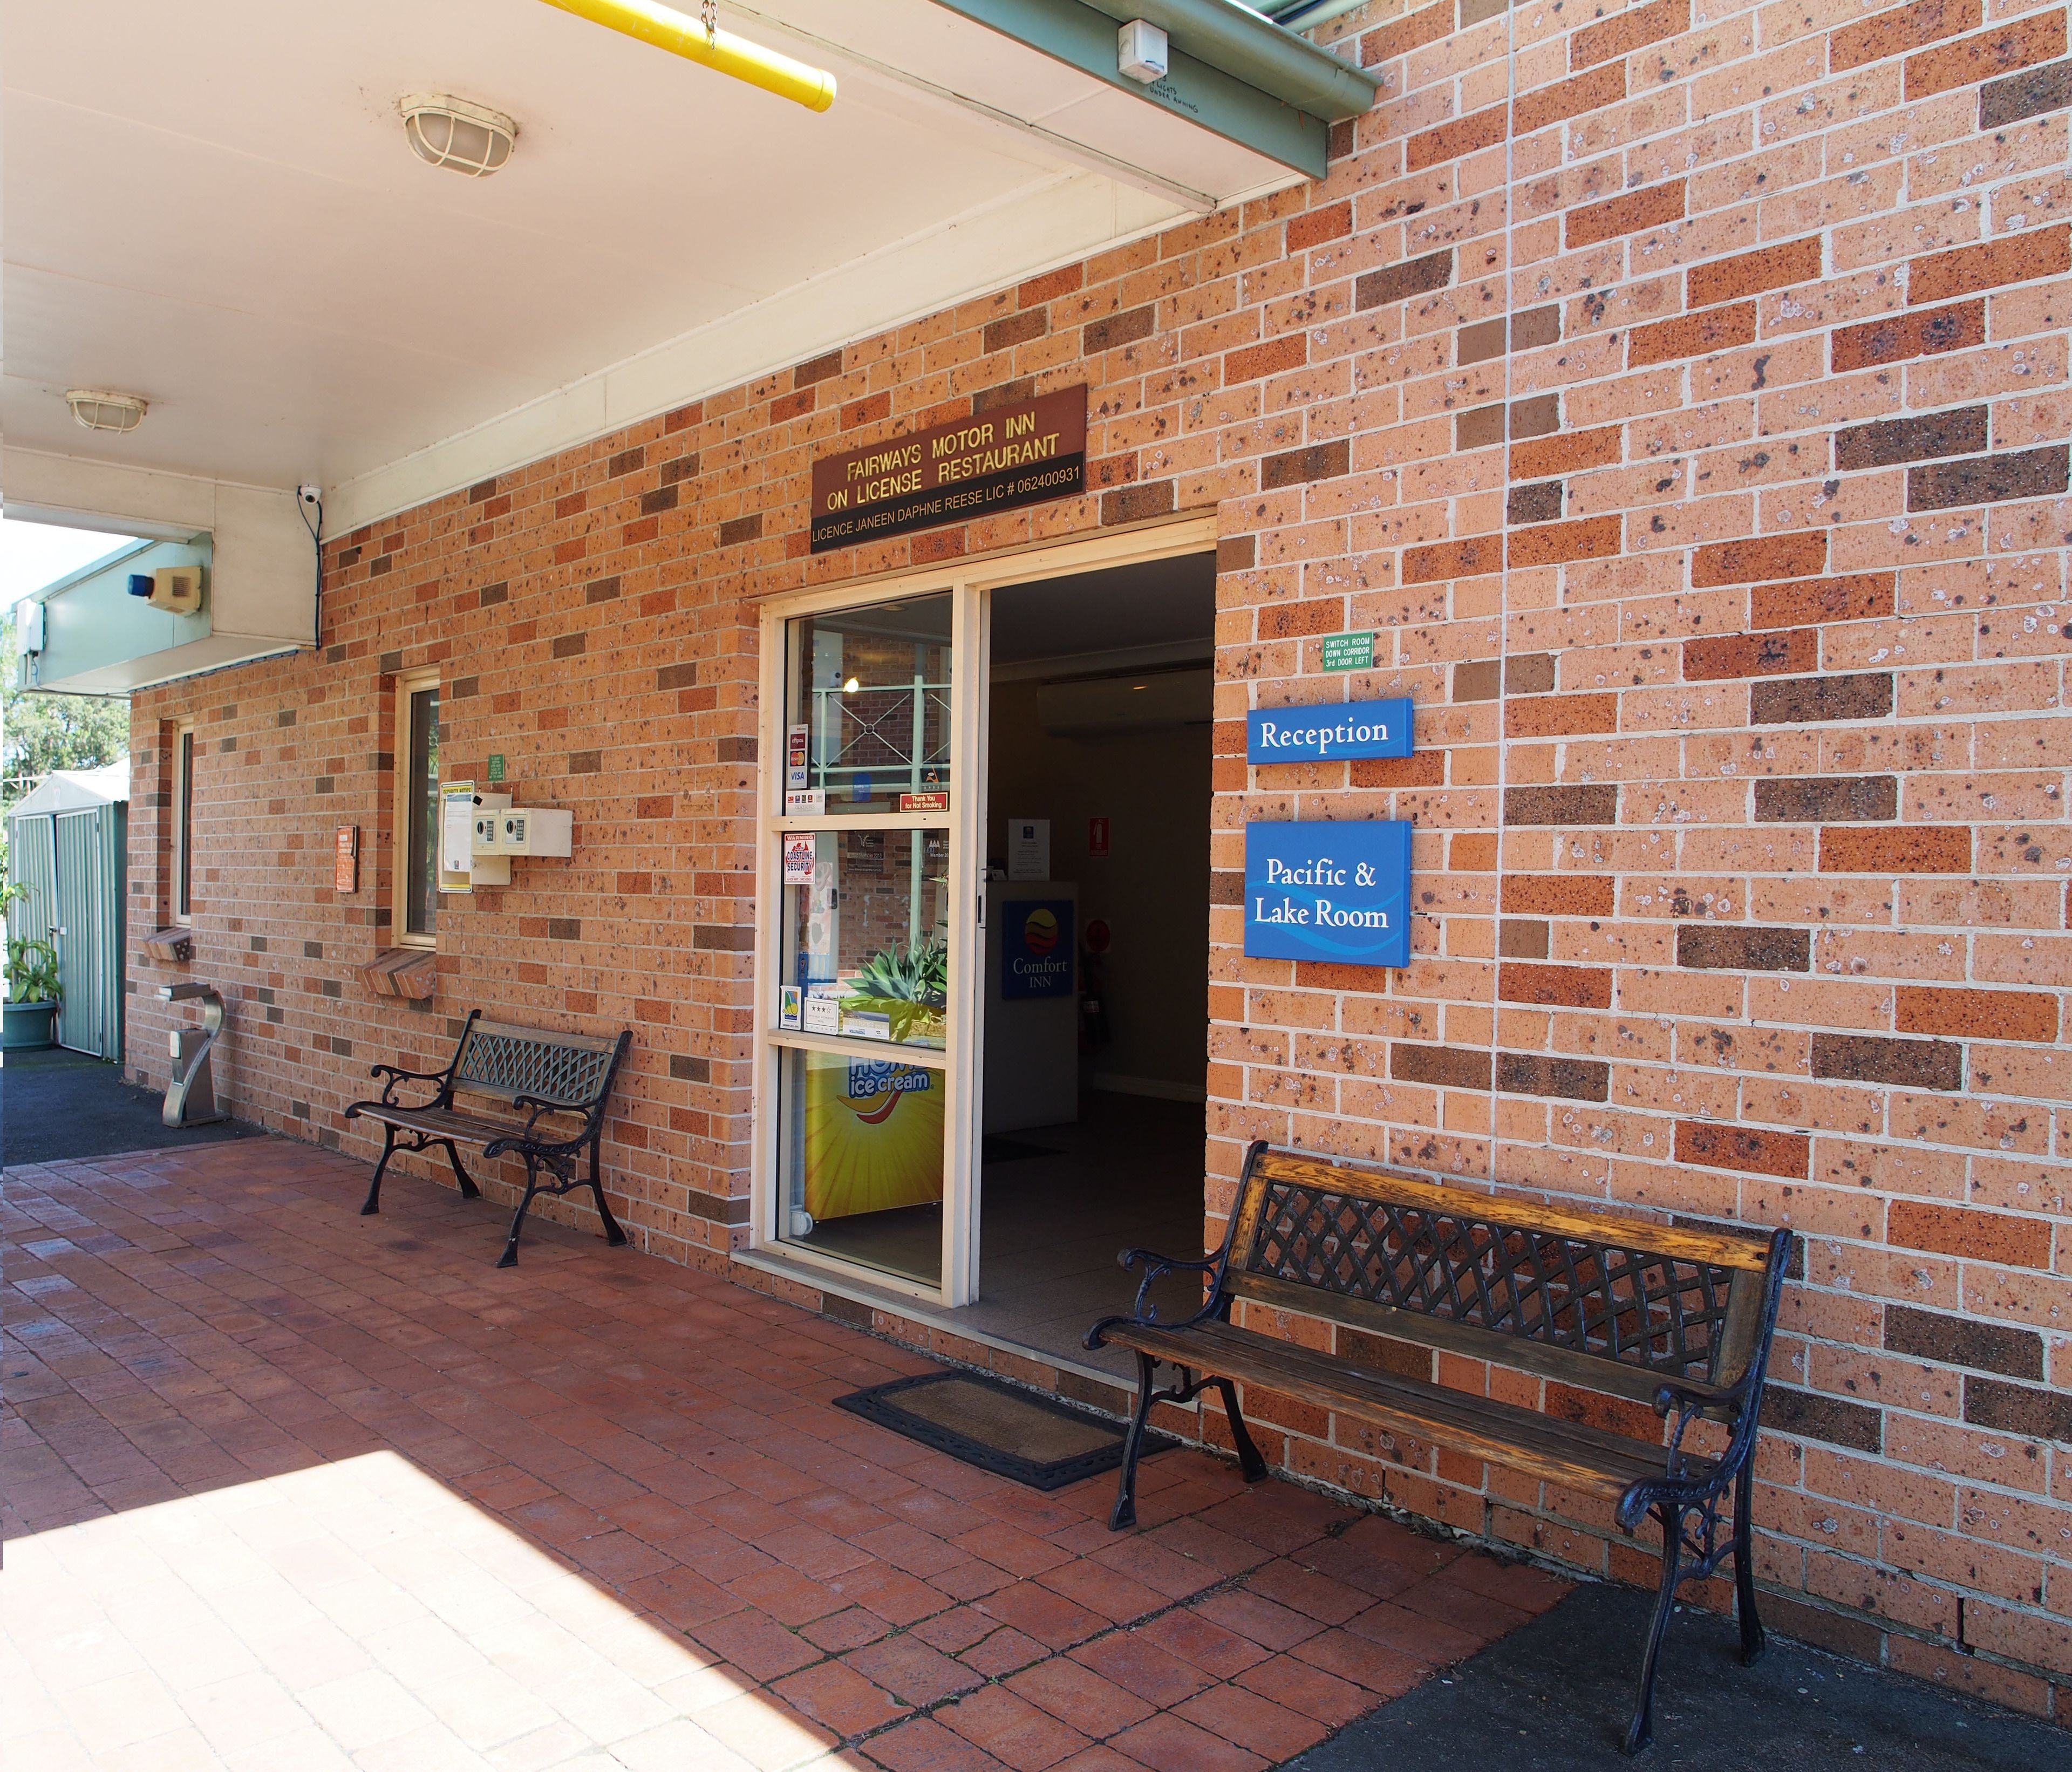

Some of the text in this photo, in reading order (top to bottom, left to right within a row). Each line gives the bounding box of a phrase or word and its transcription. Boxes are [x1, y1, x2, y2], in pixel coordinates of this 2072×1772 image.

[1157, 81, 1177, 95] LIGHTS
[1150, 85, 1198, 113] UNDER AWNING
[847, 411, 1035, 482] FAIRWAYS MOTOR INN
[827, 433, 1060, 510] ON LICENSE RESTAURANT
[812, 465, 1080, 543] LICENCE JANEEN DAPHNE REESE LIC # 062400931
[1325, 646, 1369, 658] DOWN CORRIDOR
[1326, 637, 1370, 649] SWITCH ROOM
[1326, 656, 1368, 667] 3rd DOOR LEFT
[1260, 717, 1388, 754] Reception
[790, 771, 805, 780] VISA
[787, 851, 813, 860] COASTLINE
[787, 862, 812, 871] SECURITY
[1266, 858, 1376, 886] Pacific &
[1255, 897, 1389, 928] Lake Room
[1013, 956, 1067, 974] Comfort
[1030, 976, 1052, 988] INN
[851, 1073, 928, 1095] ice cream
